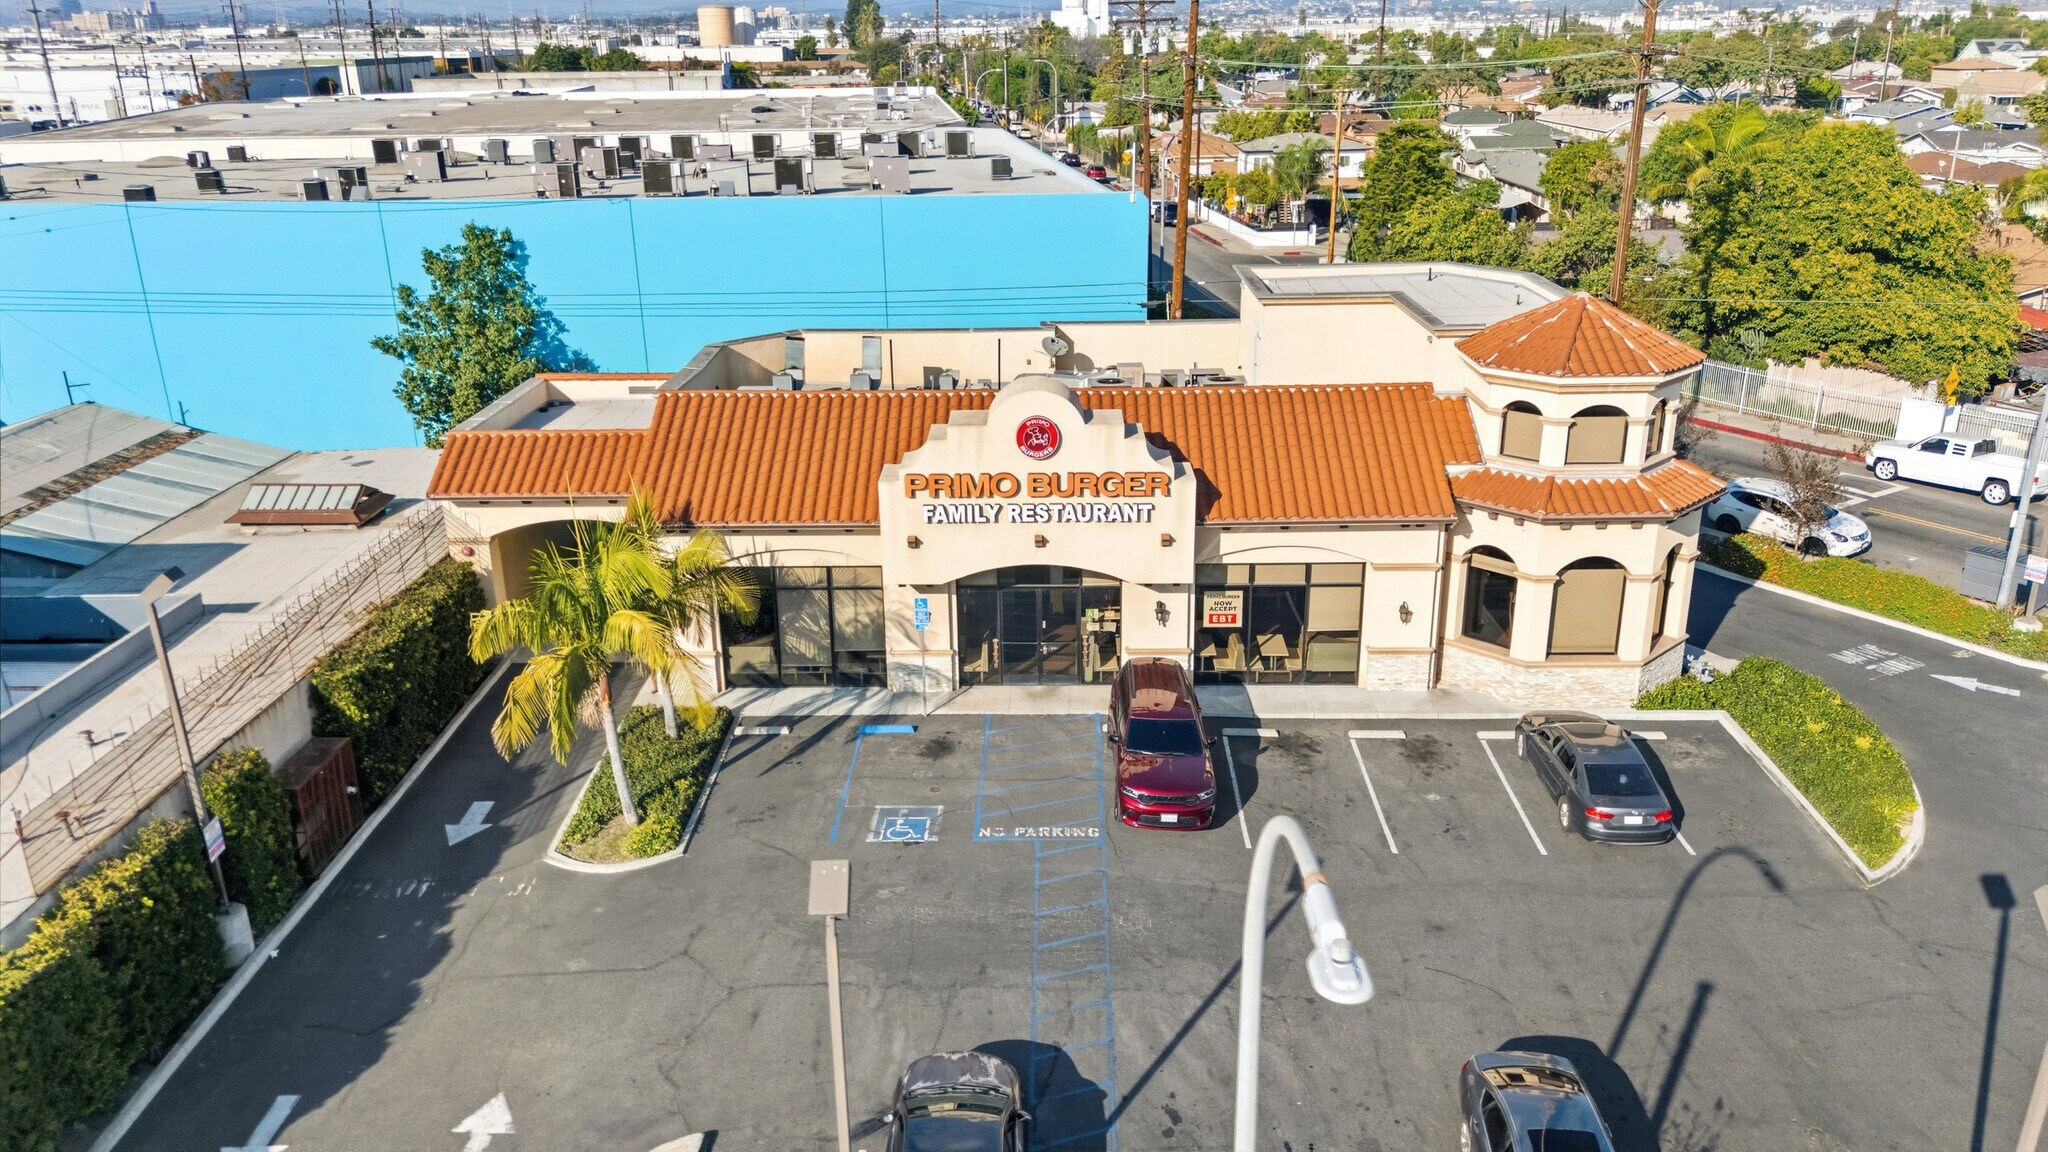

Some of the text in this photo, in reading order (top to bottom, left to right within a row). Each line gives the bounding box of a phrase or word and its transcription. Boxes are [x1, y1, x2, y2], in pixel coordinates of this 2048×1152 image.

[1025, 419, 1051, 428] PRIMO
[1020, 445, 1054, 458] BURGERS
[904, 471, 1171, 499] PRIMO BURGER
[923, 503, 1154, 524] FAMILY RESTAURANT
[1212, 615, 1234, 623] EBT
[979, 826, 1100, 837] NO PARKING
